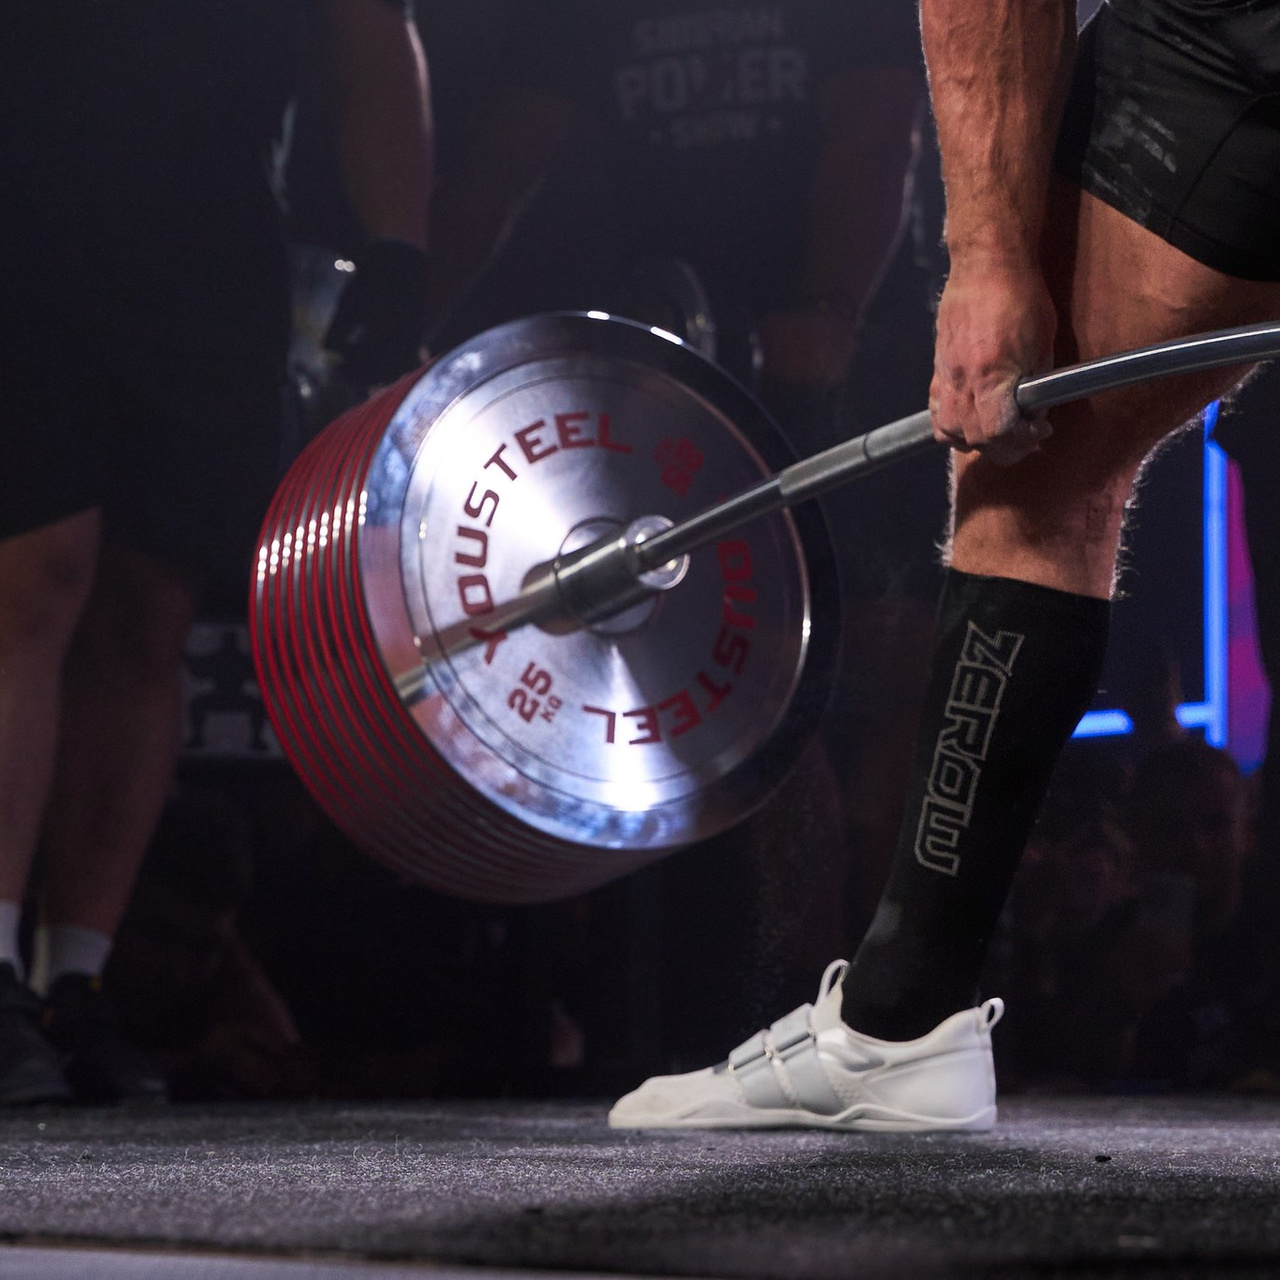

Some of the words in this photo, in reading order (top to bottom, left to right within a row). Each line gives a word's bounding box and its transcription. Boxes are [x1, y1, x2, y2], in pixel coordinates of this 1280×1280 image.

[455, 412, 634, 666] YOUSTEEL
[508, 662, 552, 723] 25
[583, 494, 757, 746] OUSTEEL
[540, 695, 563, 723] KG
